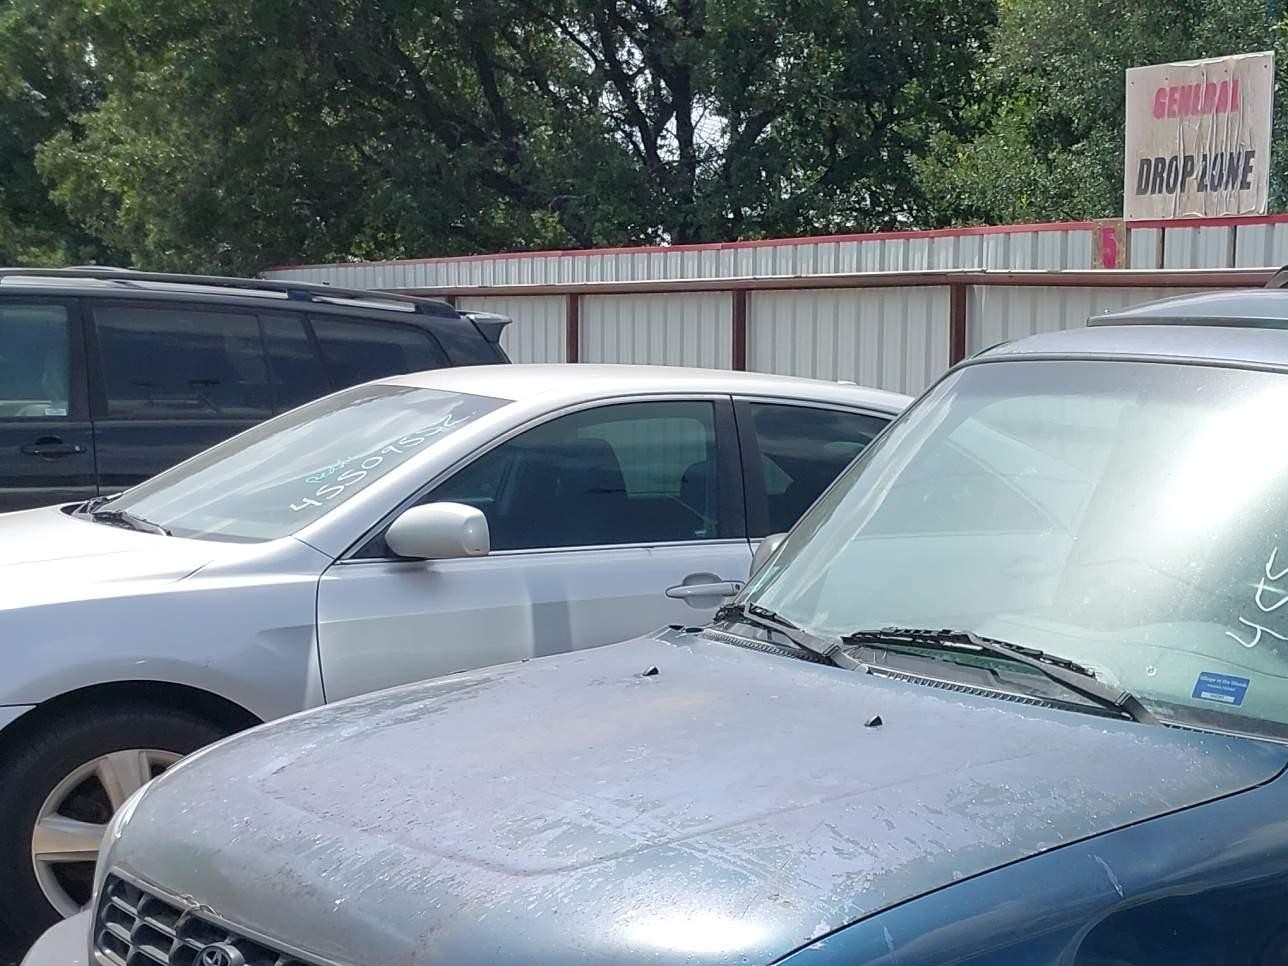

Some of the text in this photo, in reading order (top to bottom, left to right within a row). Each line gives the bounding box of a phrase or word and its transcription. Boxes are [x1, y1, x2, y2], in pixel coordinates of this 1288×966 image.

[1152, 79, 1240, 120] GENERAL
[1135, 150, 1256, 196] DROP ZONE
[1102, 227, 1118, 268] 5
